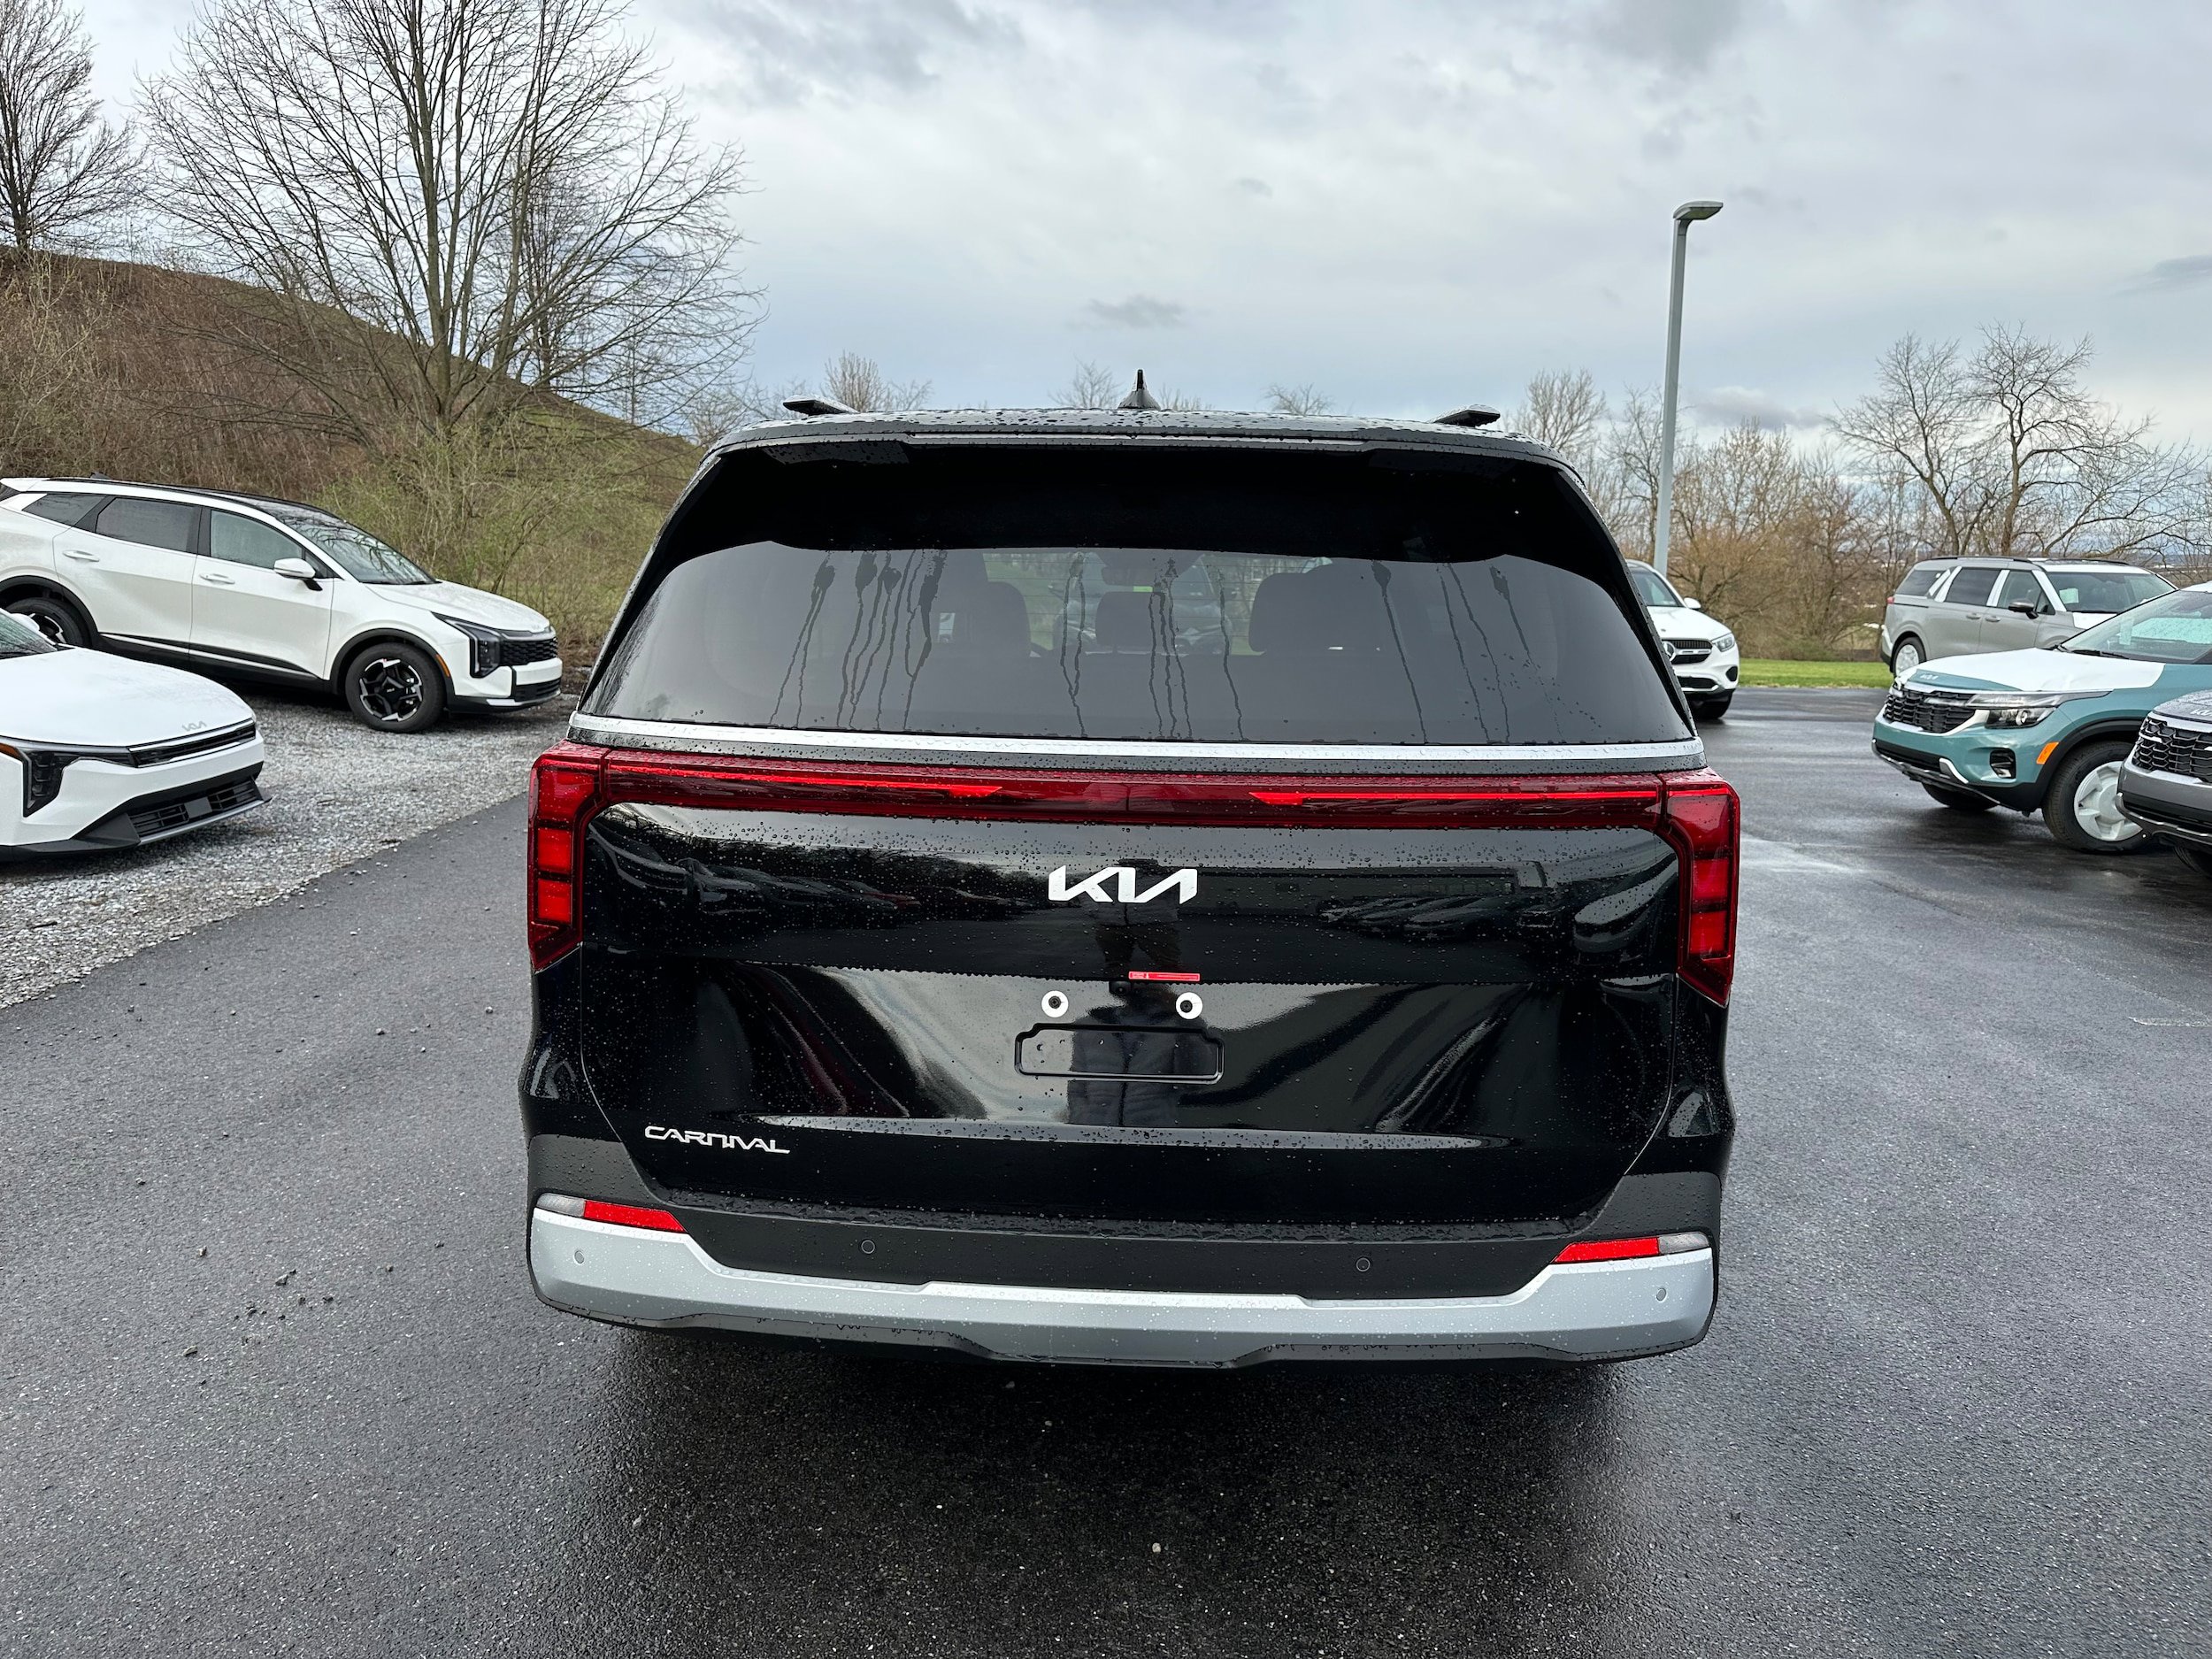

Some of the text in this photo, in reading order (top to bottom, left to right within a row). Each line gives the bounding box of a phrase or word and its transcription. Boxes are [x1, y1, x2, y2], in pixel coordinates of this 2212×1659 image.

[182, 721, 207, 732] KIA
[1048, 865, 1198, 904] KIA
[645, 1125, 790, 1155] CARNIVAL
